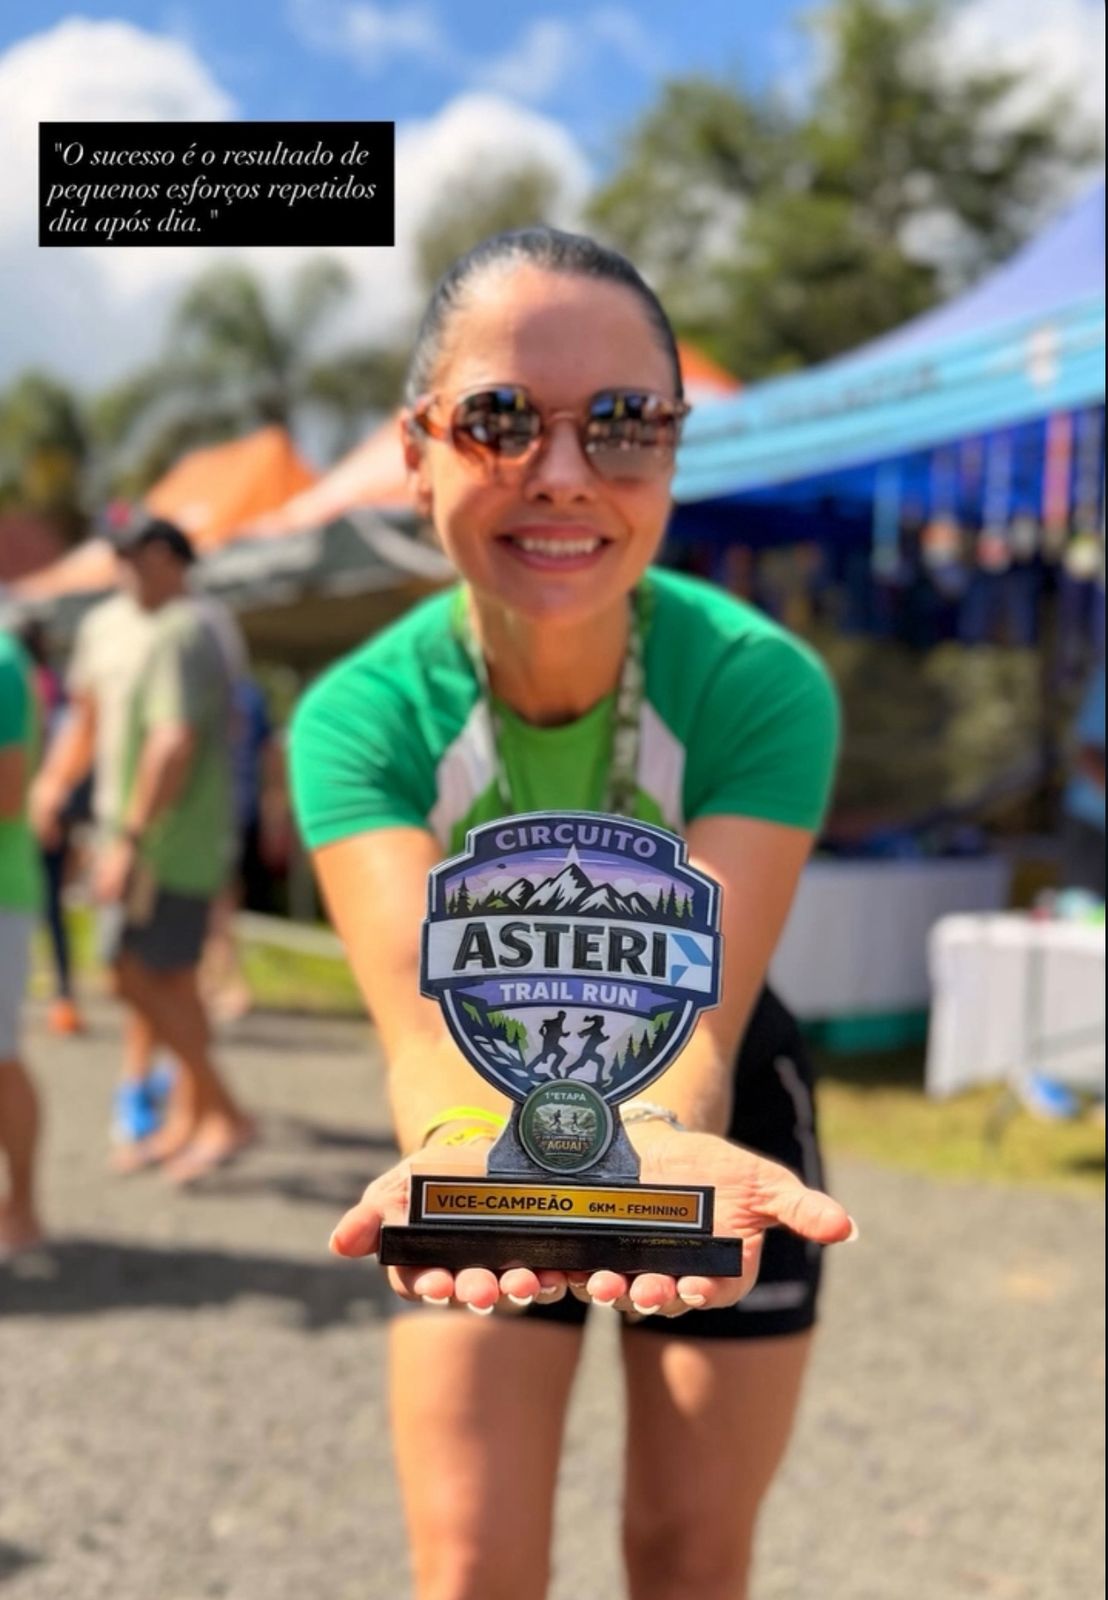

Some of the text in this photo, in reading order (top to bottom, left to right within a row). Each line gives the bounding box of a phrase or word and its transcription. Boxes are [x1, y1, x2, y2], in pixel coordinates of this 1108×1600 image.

[495, 823, 657, 858] CIRCUITO
[500, 983, 638, 1008] TRAIL RUN
[436, 1194, 574, 1212] VICE-CAMPEÃO
[588, 1203, 616, 1214] 6KM
[627, 1204, 689, 1218] FEMININO
